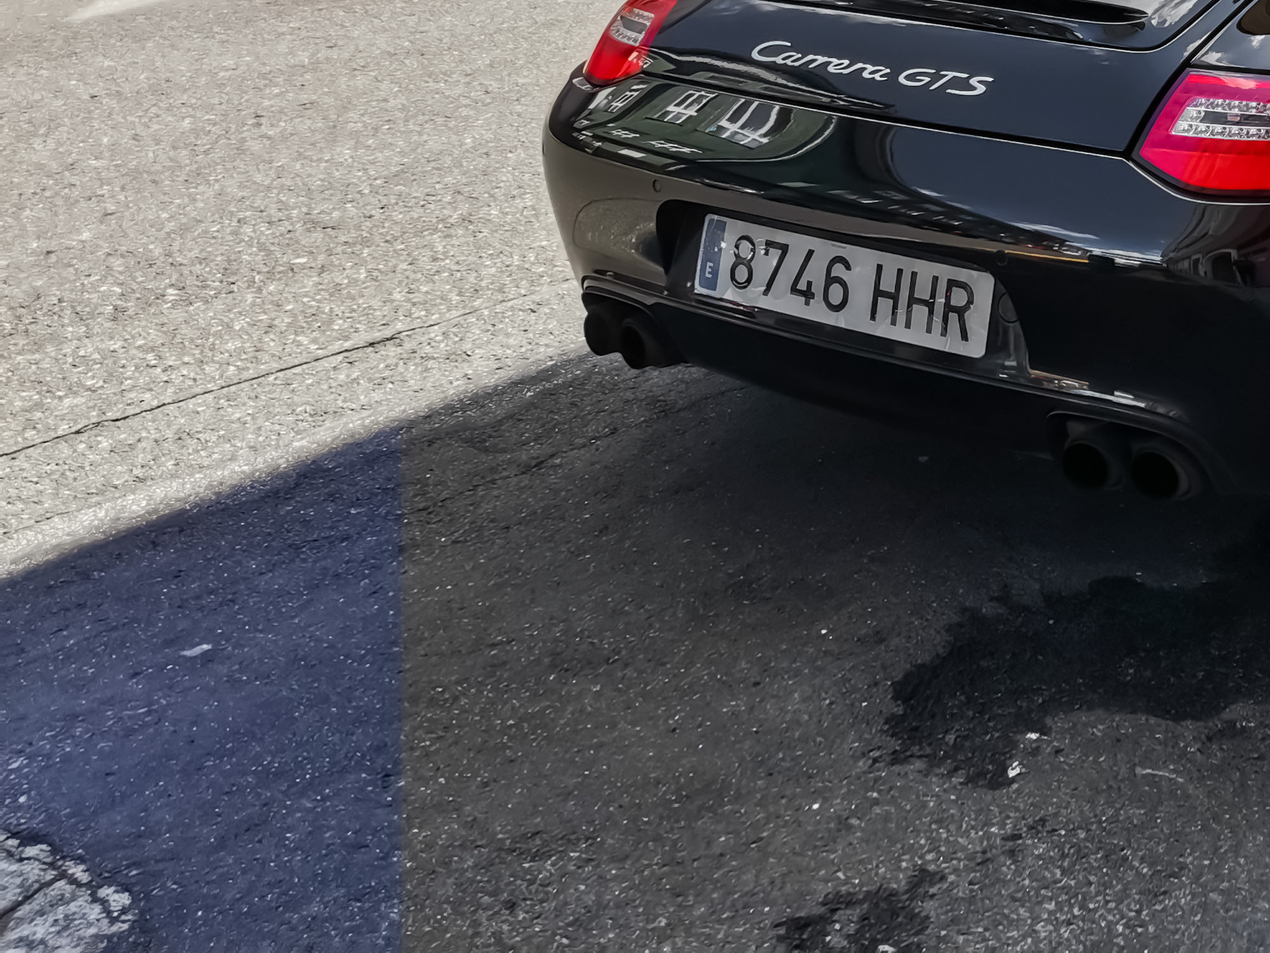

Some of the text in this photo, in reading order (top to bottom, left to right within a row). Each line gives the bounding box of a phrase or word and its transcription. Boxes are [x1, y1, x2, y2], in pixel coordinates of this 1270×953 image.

[750, 41, 994, 96] Carrera GTS
[705, 261, 714, 279] E
[730, 234, 975, 342] 8746 HHR
